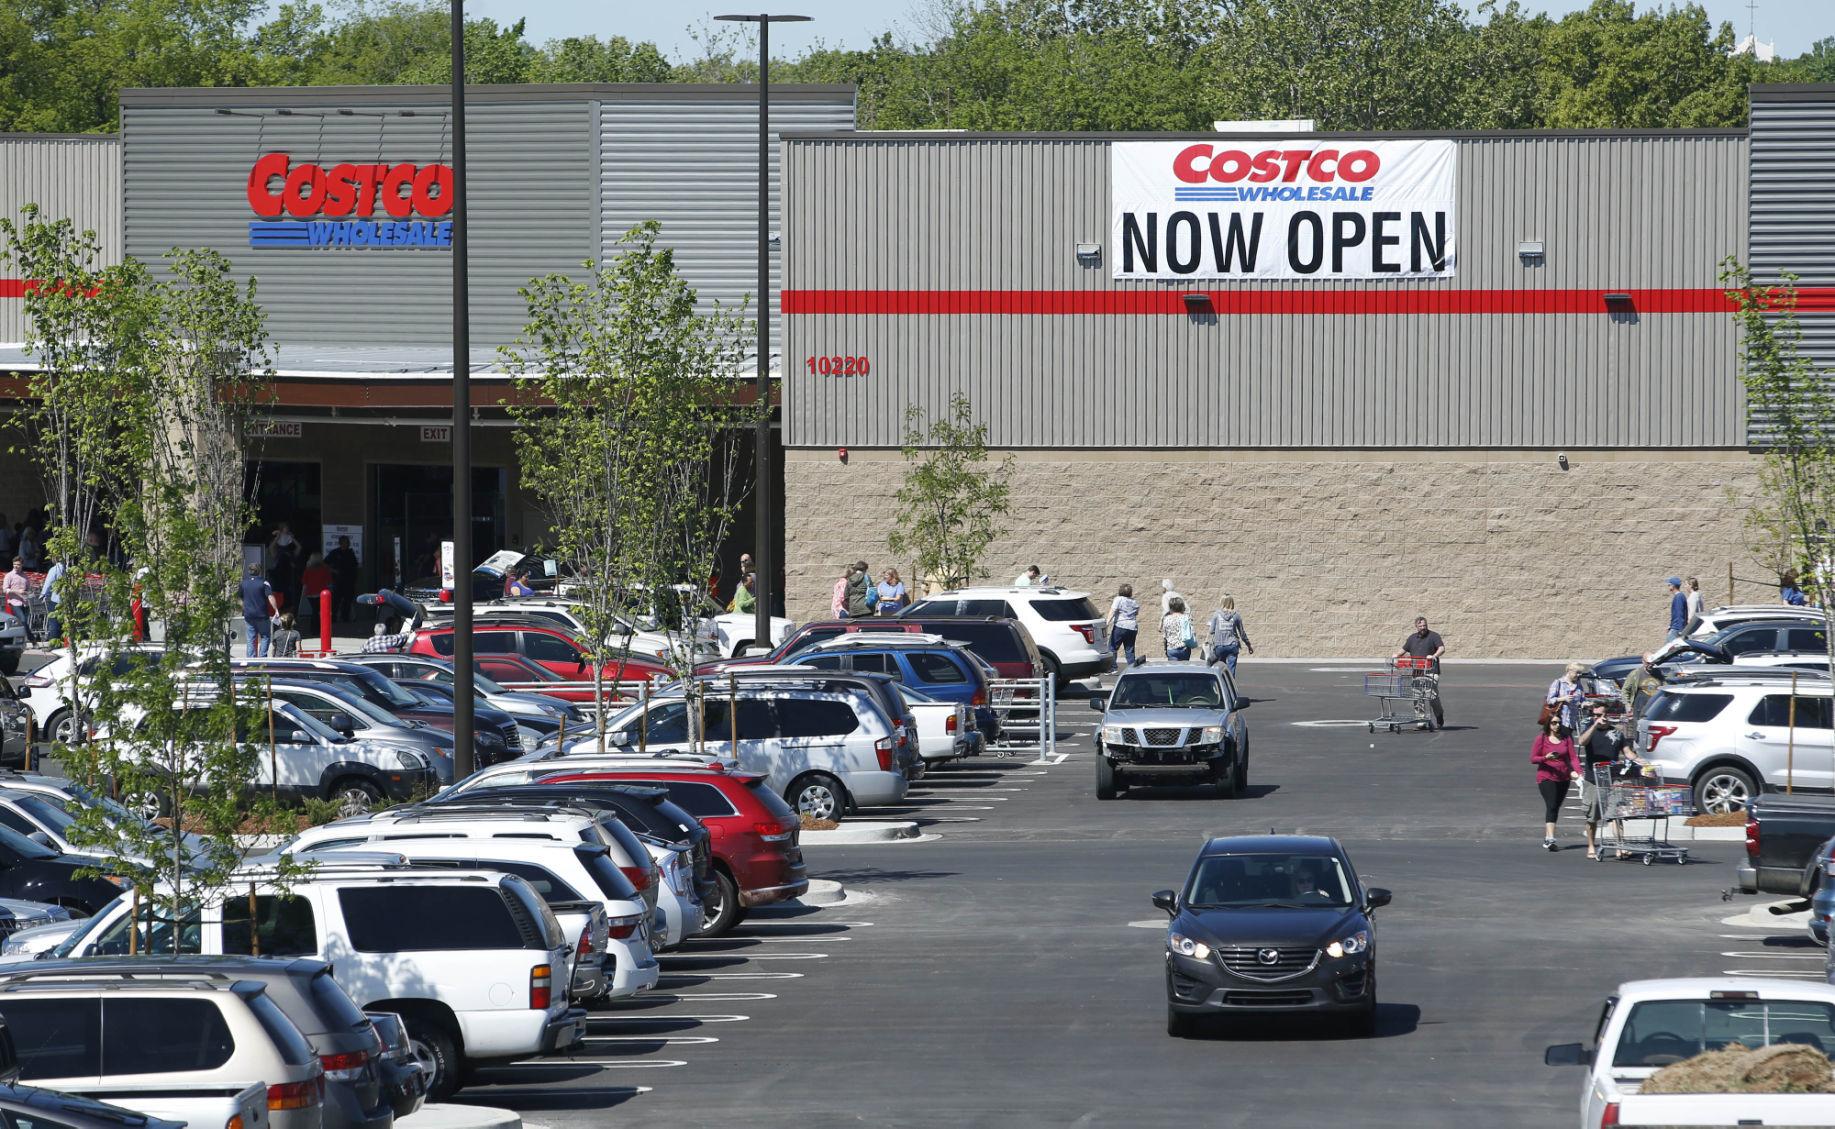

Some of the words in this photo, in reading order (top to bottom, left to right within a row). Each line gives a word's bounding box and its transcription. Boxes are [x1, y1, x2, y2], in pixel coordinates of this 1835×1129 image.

[1173, 143, 1381, 184] COSTCO
[247, 152, 454, 217] COSTCO
[1237, 186, 1374, 202] WHOLESALE
[306, 221, 453, 246] WHOLESALE
[1122, 211, 1264, 275] NOW
[1287, 211, 1447, 275] OPEN
[806, 356, 870, 376] 10220
[424, 428, 448, 440] EXIT
